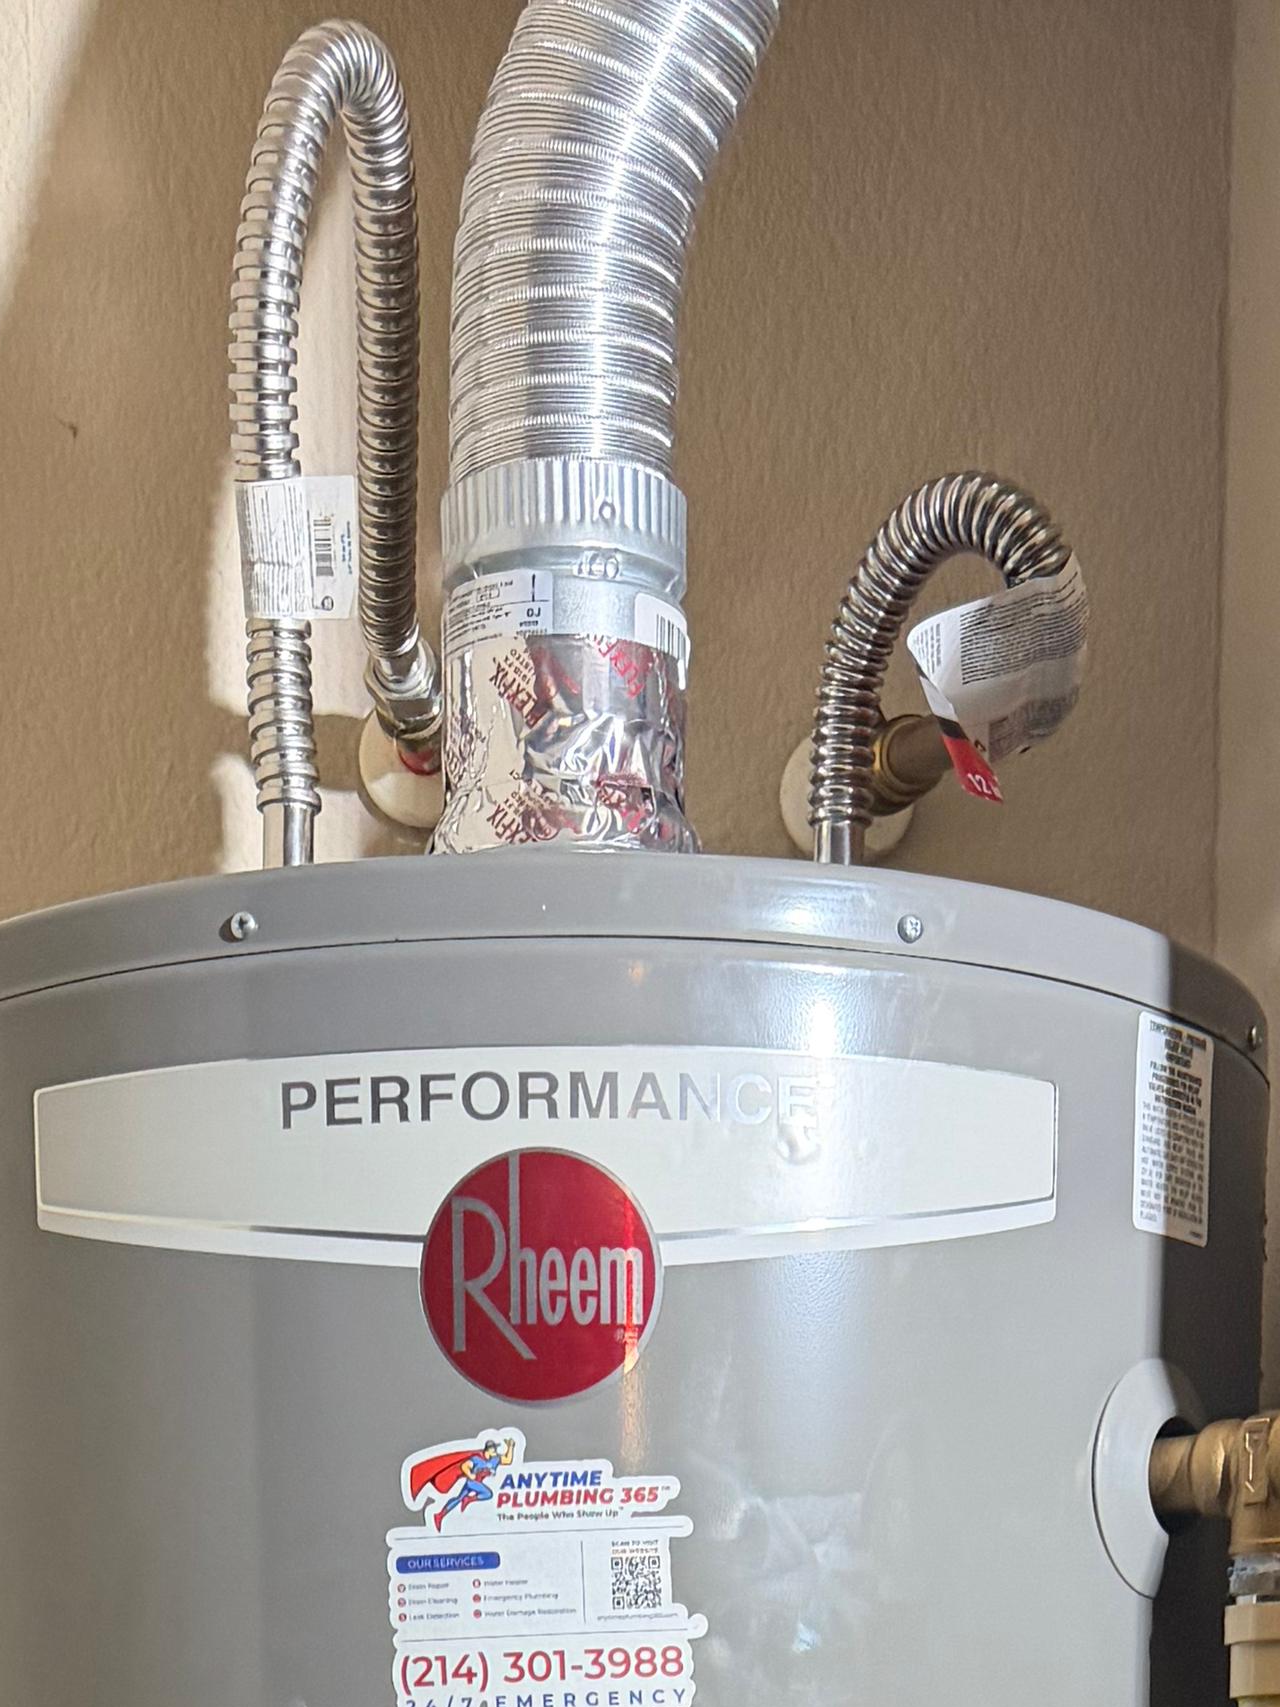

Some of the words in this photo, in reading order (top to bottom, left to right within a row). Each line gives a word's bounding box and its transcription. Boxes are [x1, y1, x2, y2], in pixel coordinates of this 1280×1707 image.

[281, 1070, 819, 1131] PERFORMANCE
[451, 1152, 644, 1361] Rheem
[499, 1470, 603, 1490] ANYTIME
[496, 1488, 614, 1509] PLUMBING
[496, 1512, 515, 1521] The
[516, 1511, 549, 1521] People
[551, 1510, 575, 1519] Who
[575, 1510, 604, 1519] Show
[407, 1558, 432, 1569] OUR
[432, 1556, 484, 1568] SERVICES
[483, 1594, 523, 1603] Emergency
[523, 1591, 559, 1602] Plumbing
[425, 1611, 460, 1620] Detection
[536, 1606, 577, 1615] Restoration
[400, 1651, 489, 1695] (214)
[503, 1645, 684, 1683] 301-3988
